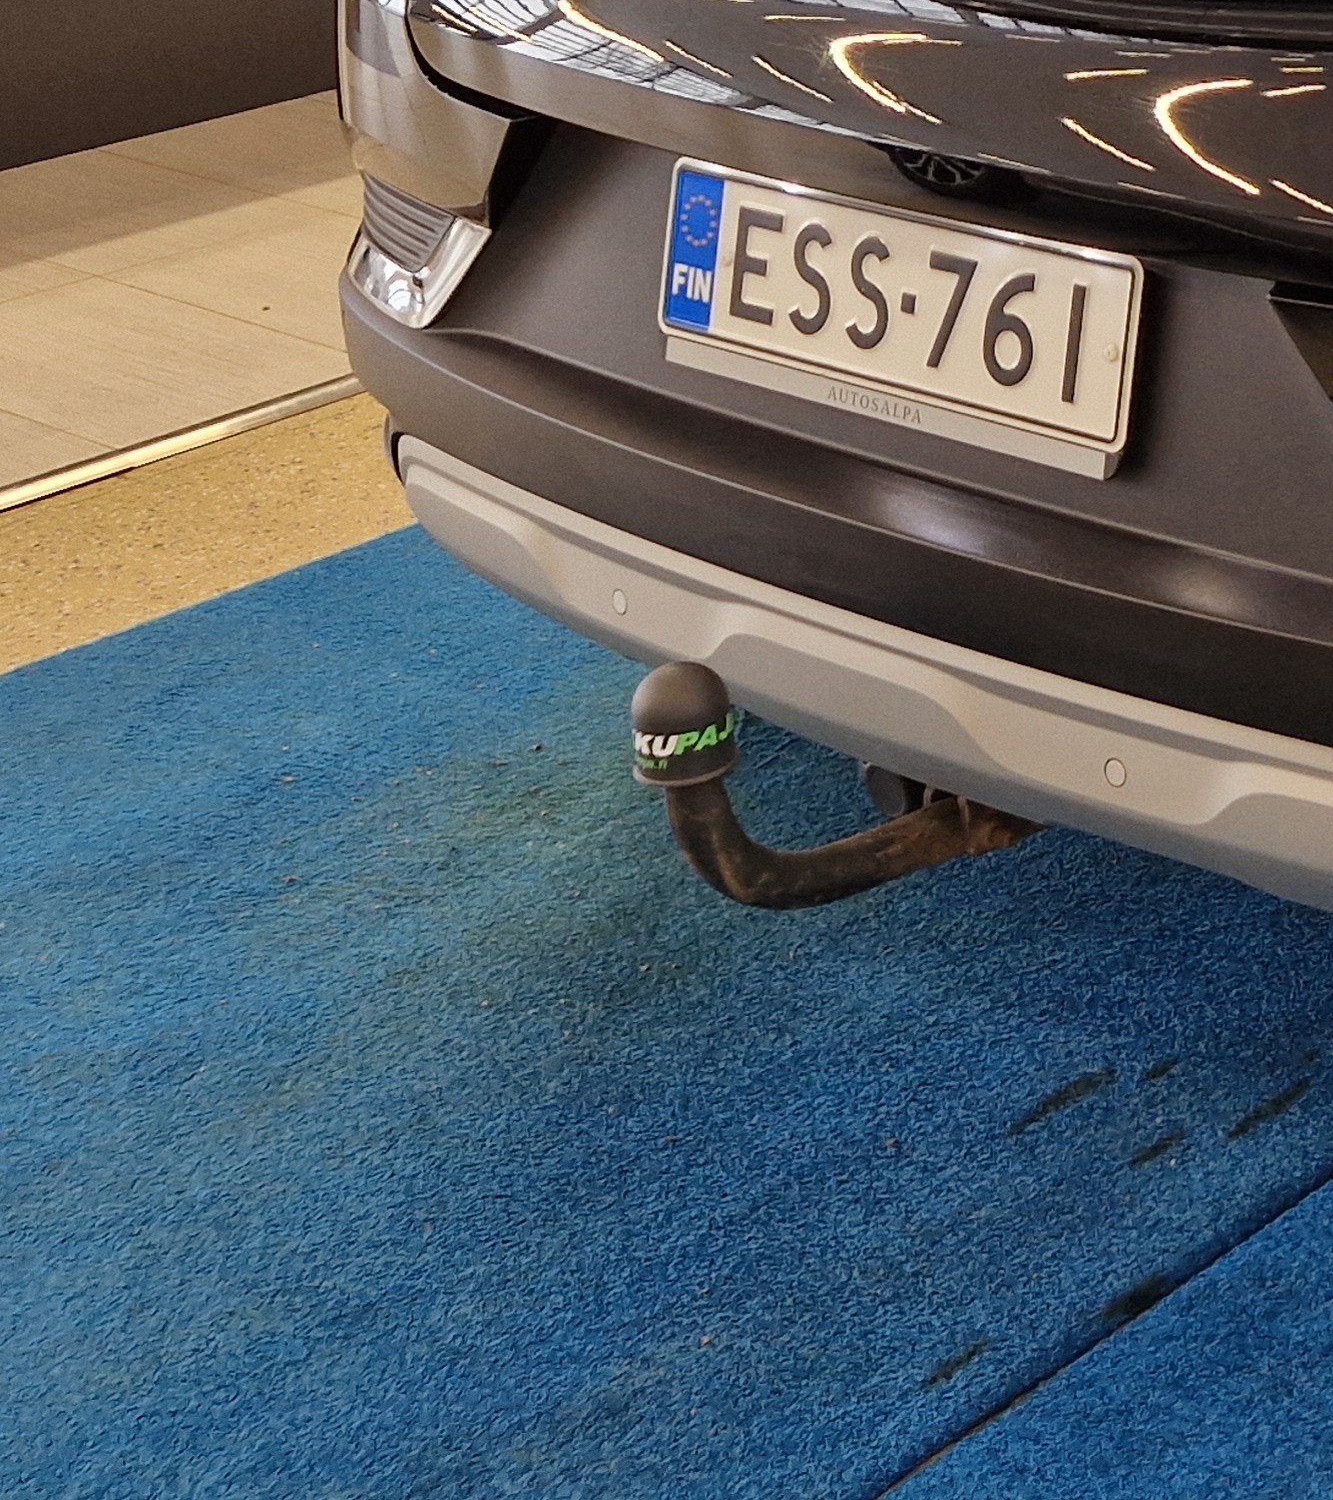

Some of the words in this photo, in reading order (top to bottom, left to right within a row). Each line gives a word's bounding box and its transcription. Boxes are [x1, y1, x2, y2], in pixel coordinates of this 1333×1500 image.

[671, 262, 714, 304] FIN
[728, 205, 1088, 404] ESS-761
[827, 384, 922, 425] AUTOSALPA
